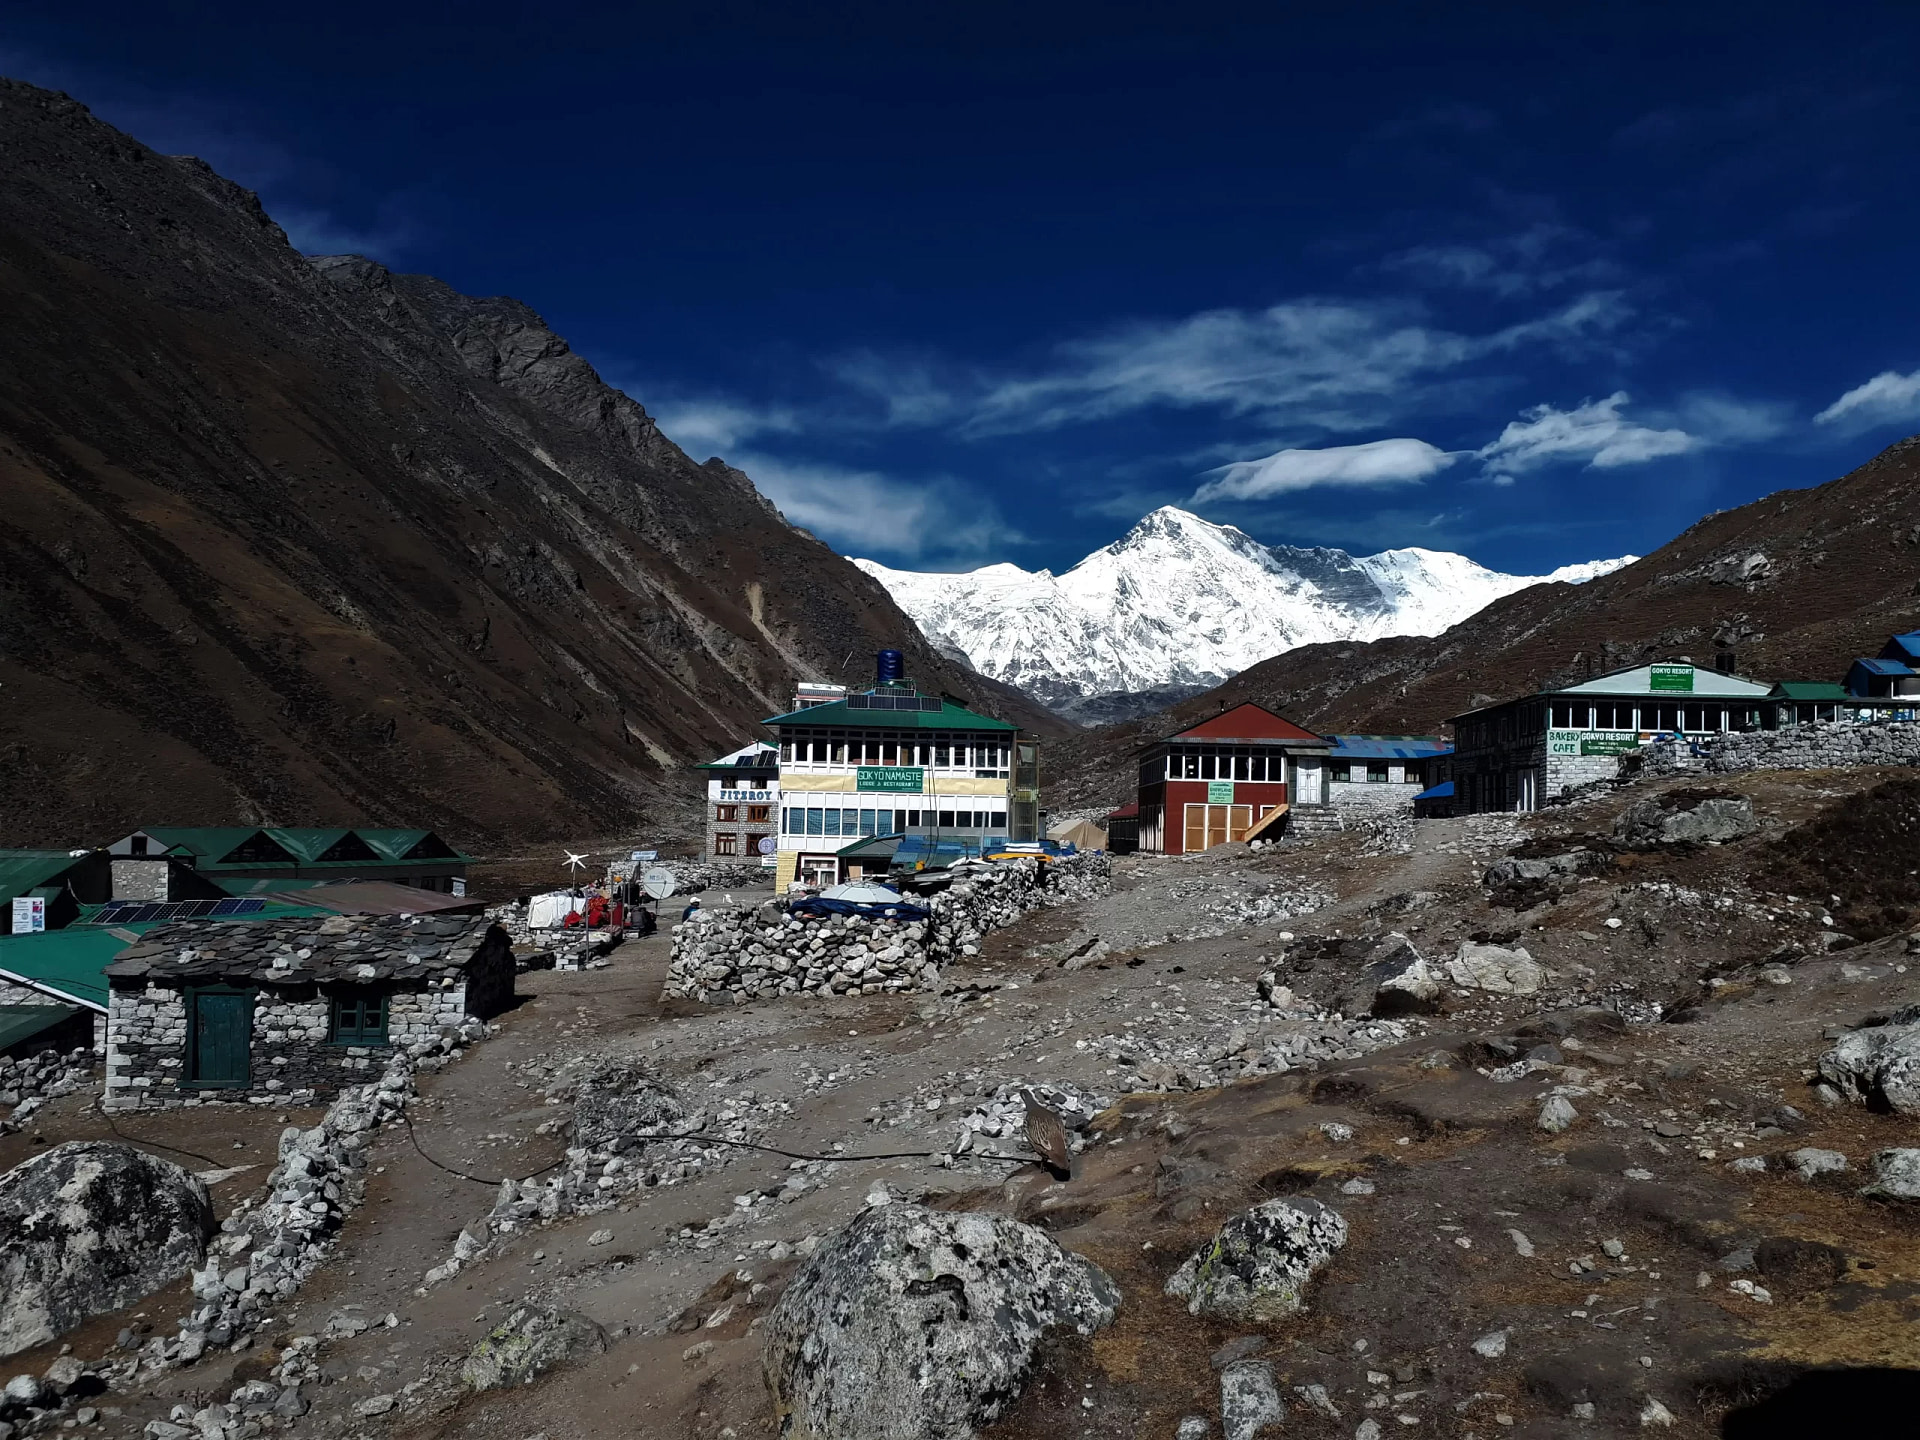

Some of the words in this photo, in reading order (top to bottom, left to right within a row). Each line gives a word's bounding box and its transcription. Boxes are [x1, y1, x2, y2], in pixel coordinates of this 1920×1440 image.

[1581, 732, 1604, 741] GOKYO
[1605, 733, 1635, 742] RESORT
[1552, 743, 1576, 754] CAFE
[857, 770, 884, 780] GOKYO
[885, 771, 922, 781] NAMASTE
[720, 790, 772, 801] FITZROY
